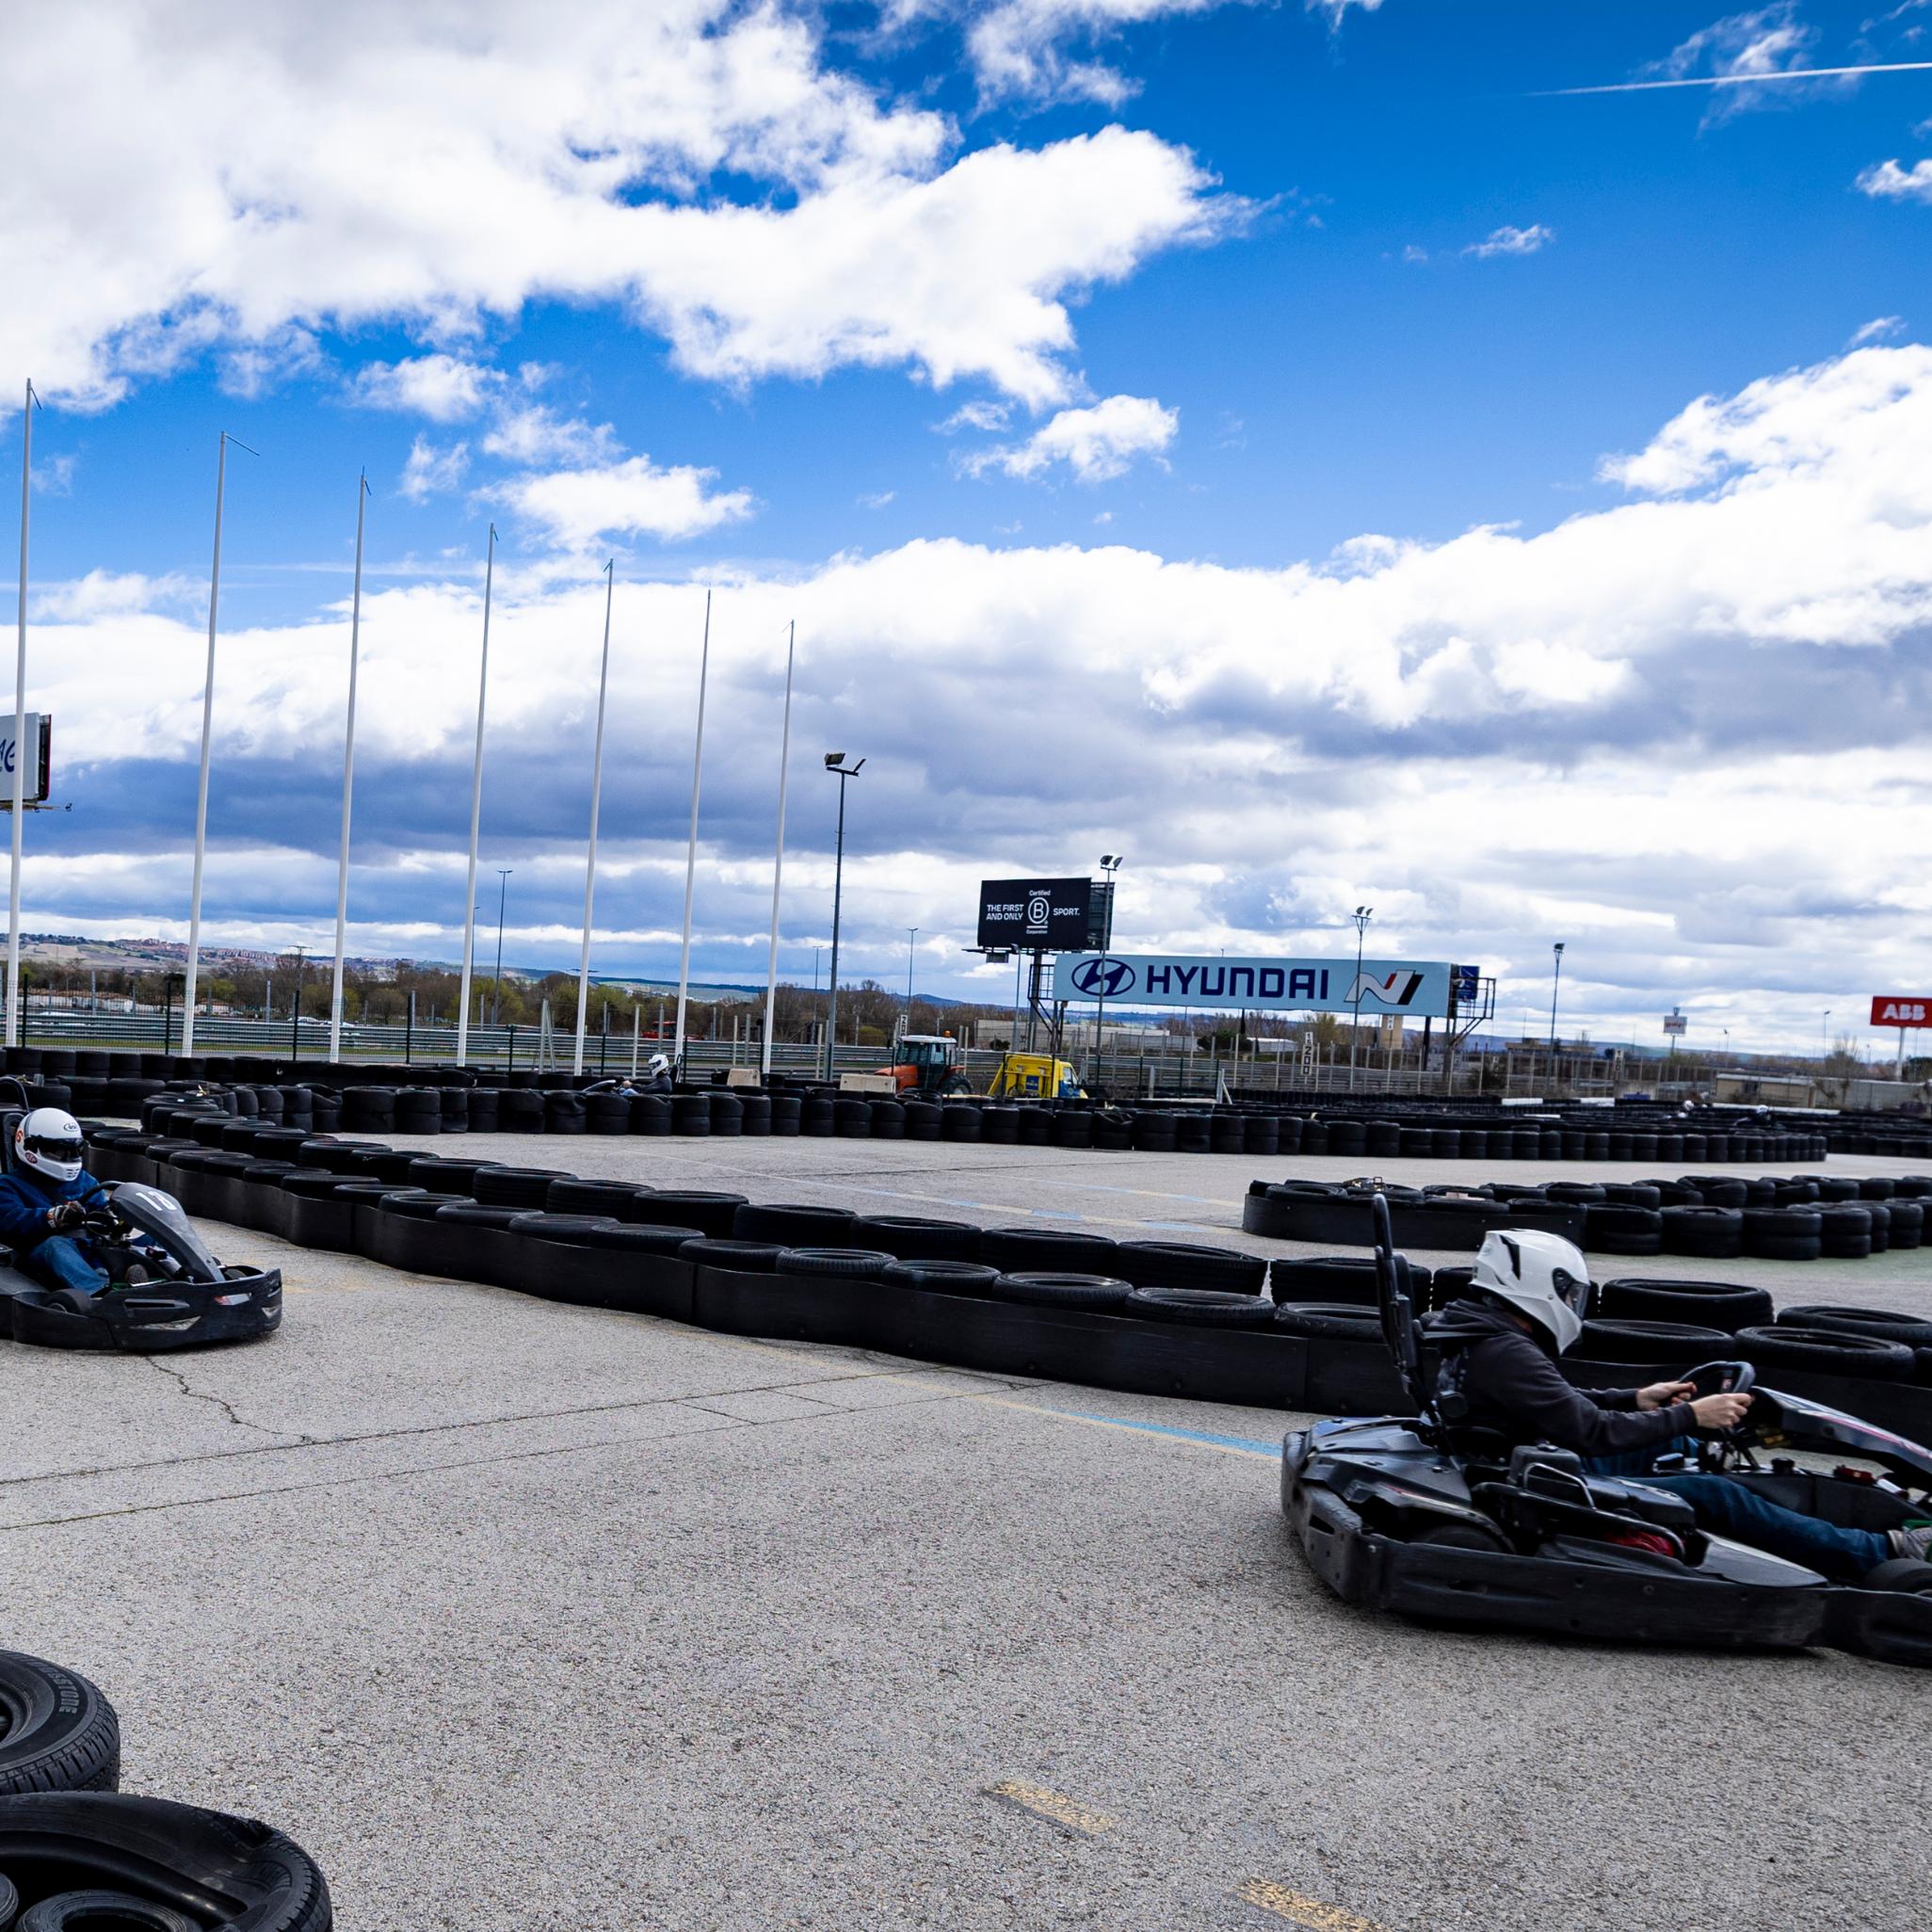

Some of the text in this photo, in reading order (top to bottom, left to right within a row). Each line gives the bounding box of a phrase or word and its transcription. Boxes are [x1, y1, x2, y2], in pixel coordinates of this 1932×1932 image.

[986, 912, 1024, 921] AND ONLY
[1033, 902, 1044, 919] B
[1053, 908, 1081, 916] SPORT.
[1147, 964, 1329, 1000] HYUNDAI
[1882, 1003, 1926, 1021] ABB
[1302, 1046, 1312, 1074] 200
